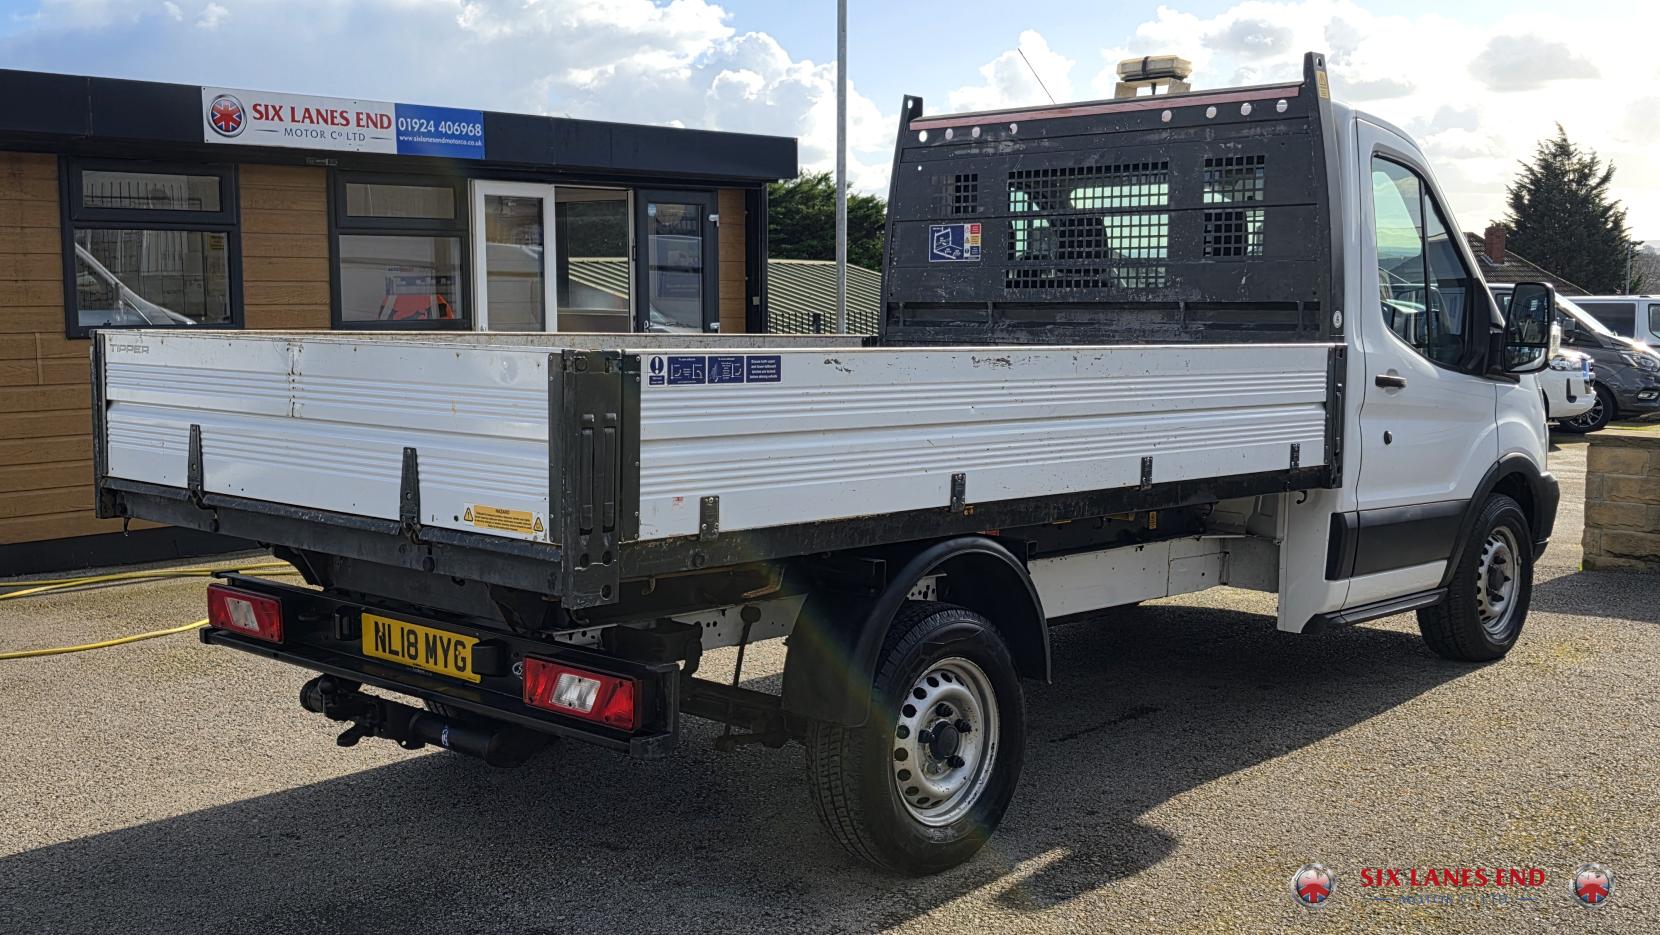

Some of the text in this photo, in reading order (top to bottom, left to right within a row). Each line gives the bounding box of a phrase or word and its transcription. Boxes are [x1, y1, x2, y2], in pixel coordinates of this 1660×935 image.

[252, 103, 393, 130] SIX LANES END
[284, 127, 326, 140] MOTOR
[346, 132, 366, 142] LTD
[398, 117, 482, 137] 01924 406968
[110, 343, 150, 354] TIPPER
[374, 621, 467, 673] NL18 MYG
